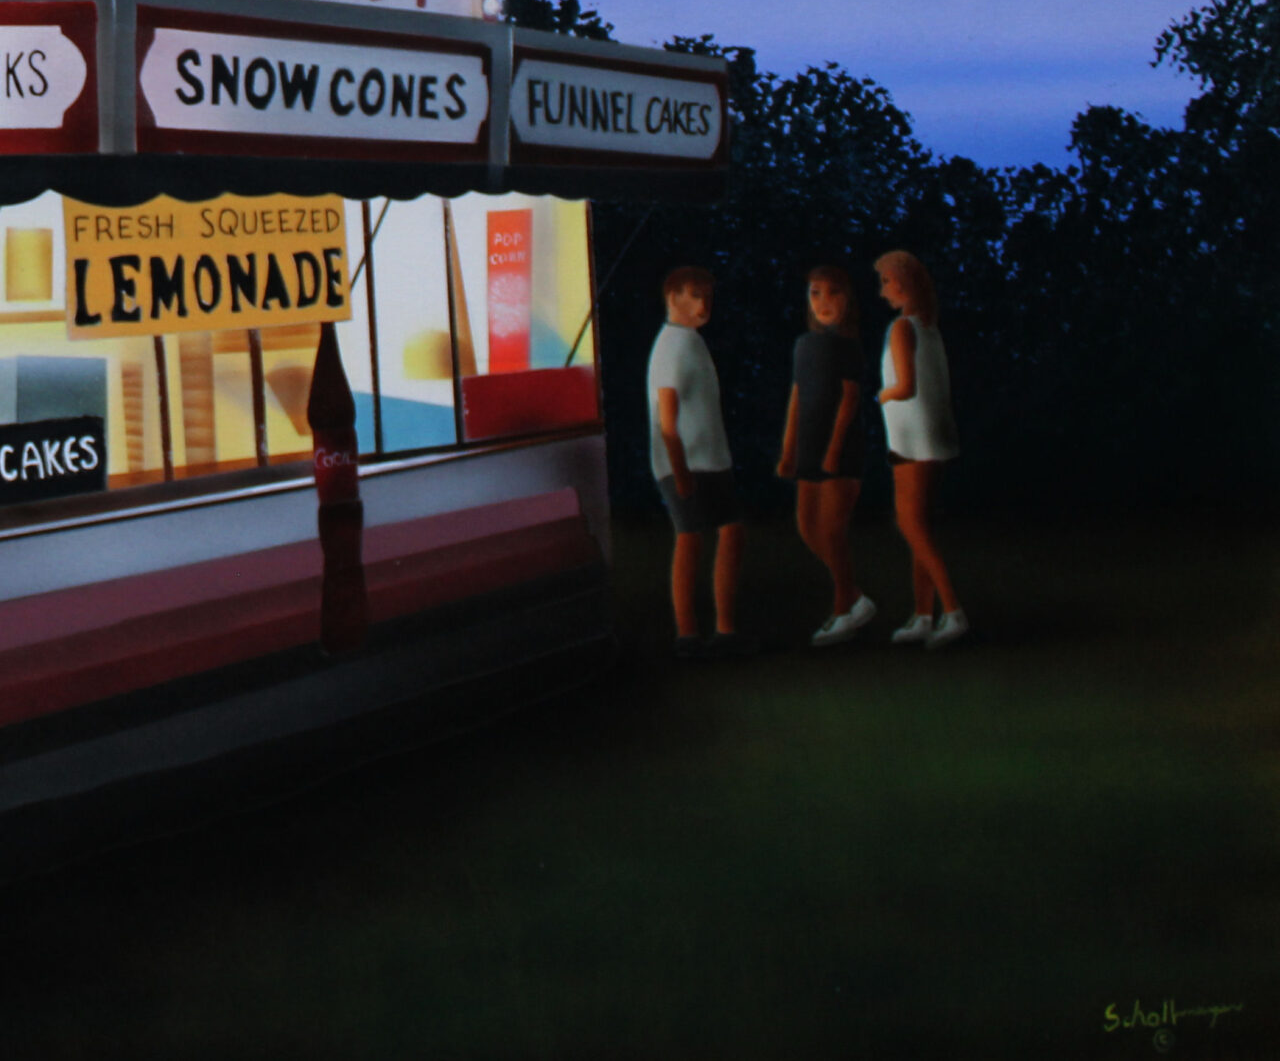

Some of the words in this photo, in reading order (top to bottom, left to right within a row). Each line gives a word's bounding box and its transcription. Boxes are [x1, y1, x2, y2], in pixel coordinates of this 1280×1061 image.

[175, 48, 319, 112] SNOW
[330, 67, 468, 121] CONES
[528, 78, 639, 134] FUNNEL
[645, 95, 714, 137] CAKES
[73, 213, 175, 242] FRESH
[200, 206, 342, 237] SQUEEZED
[73, 246, 344, 327] LEMONADE
